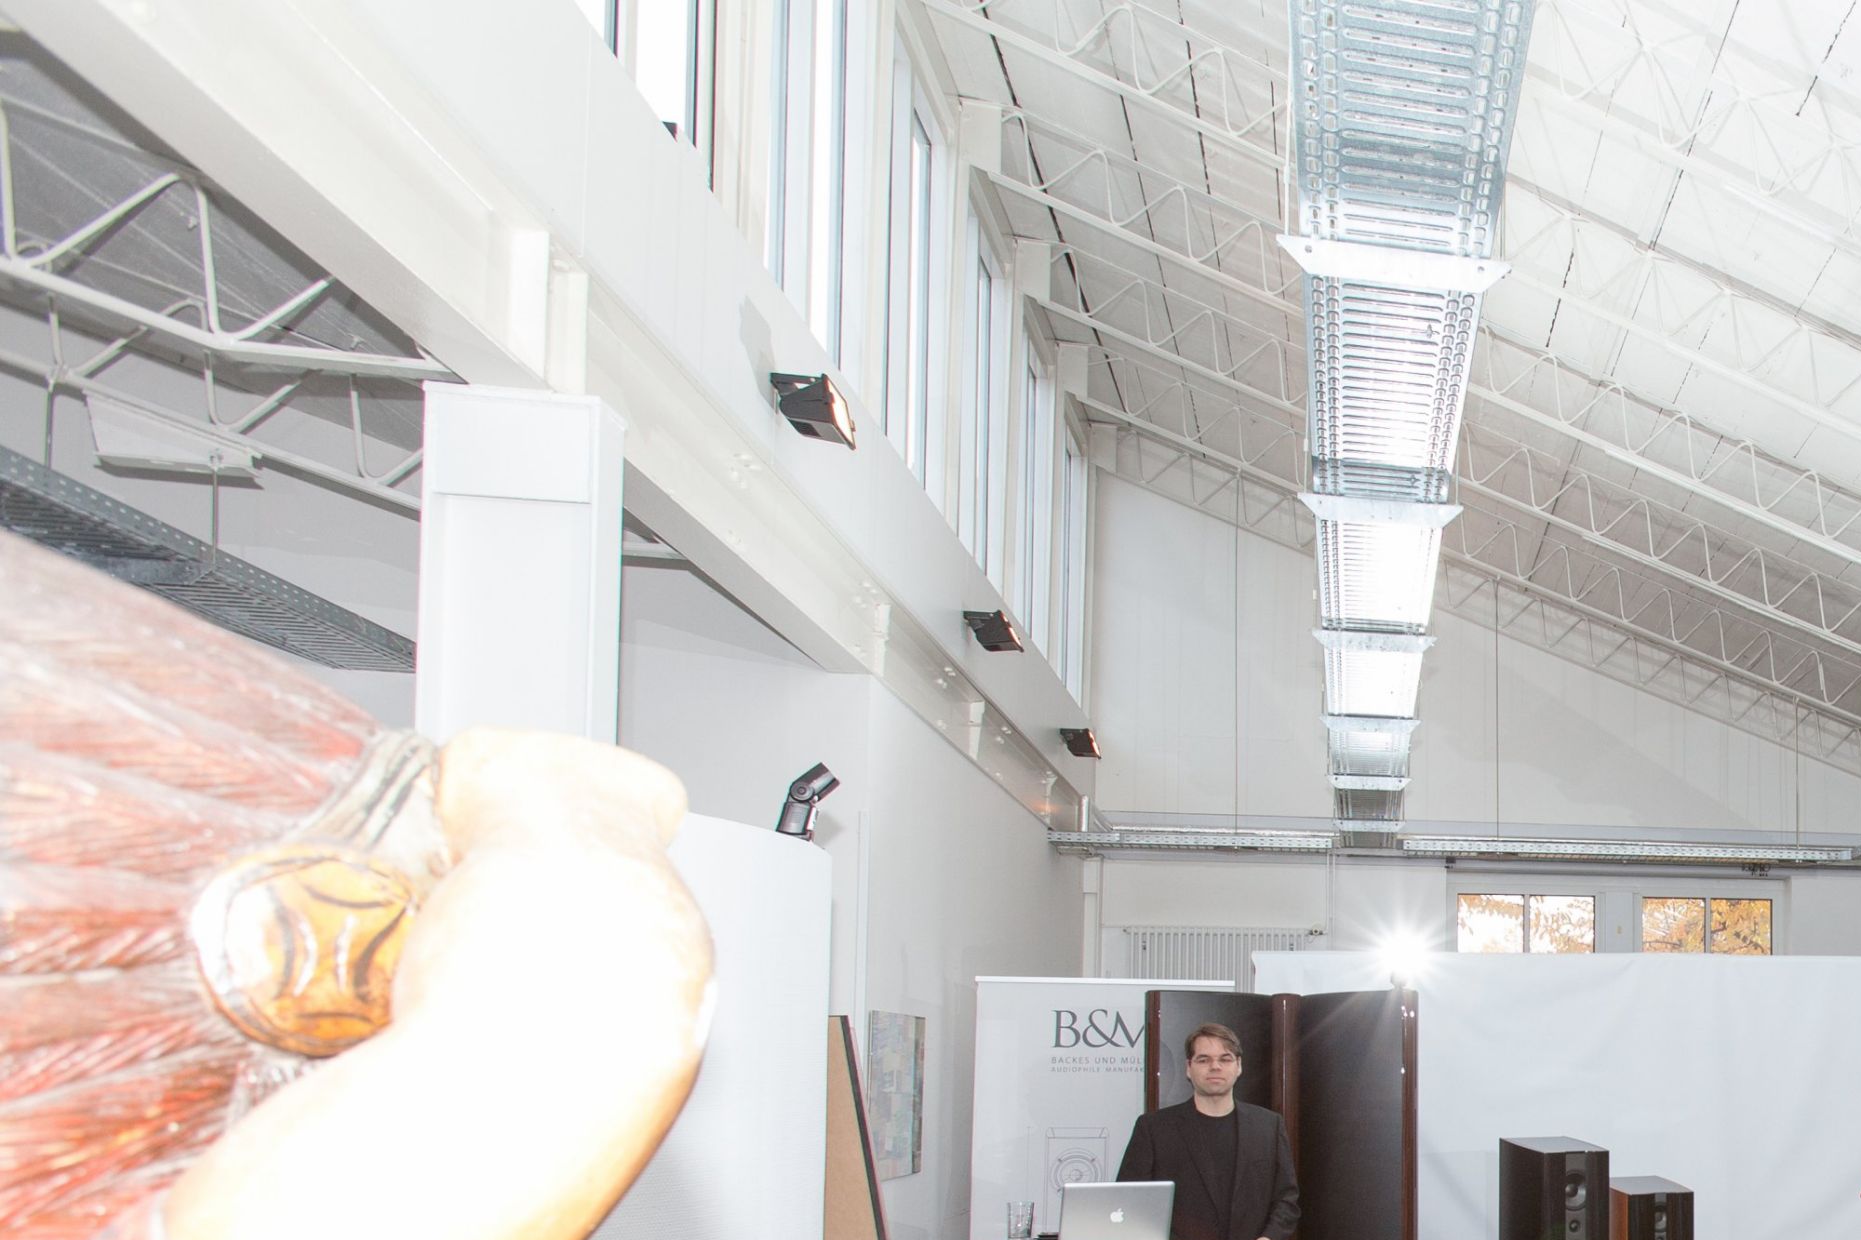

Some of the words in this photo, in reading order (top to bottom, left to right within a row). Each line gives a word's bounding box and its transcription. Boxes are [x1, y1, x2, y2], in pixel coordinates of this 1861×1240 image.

[1051, 1056, 1090, 1064] BACKES
[1094, 1056, 1116, 1064] UND
[1120, 1055, 1142, 1064] MÜL
